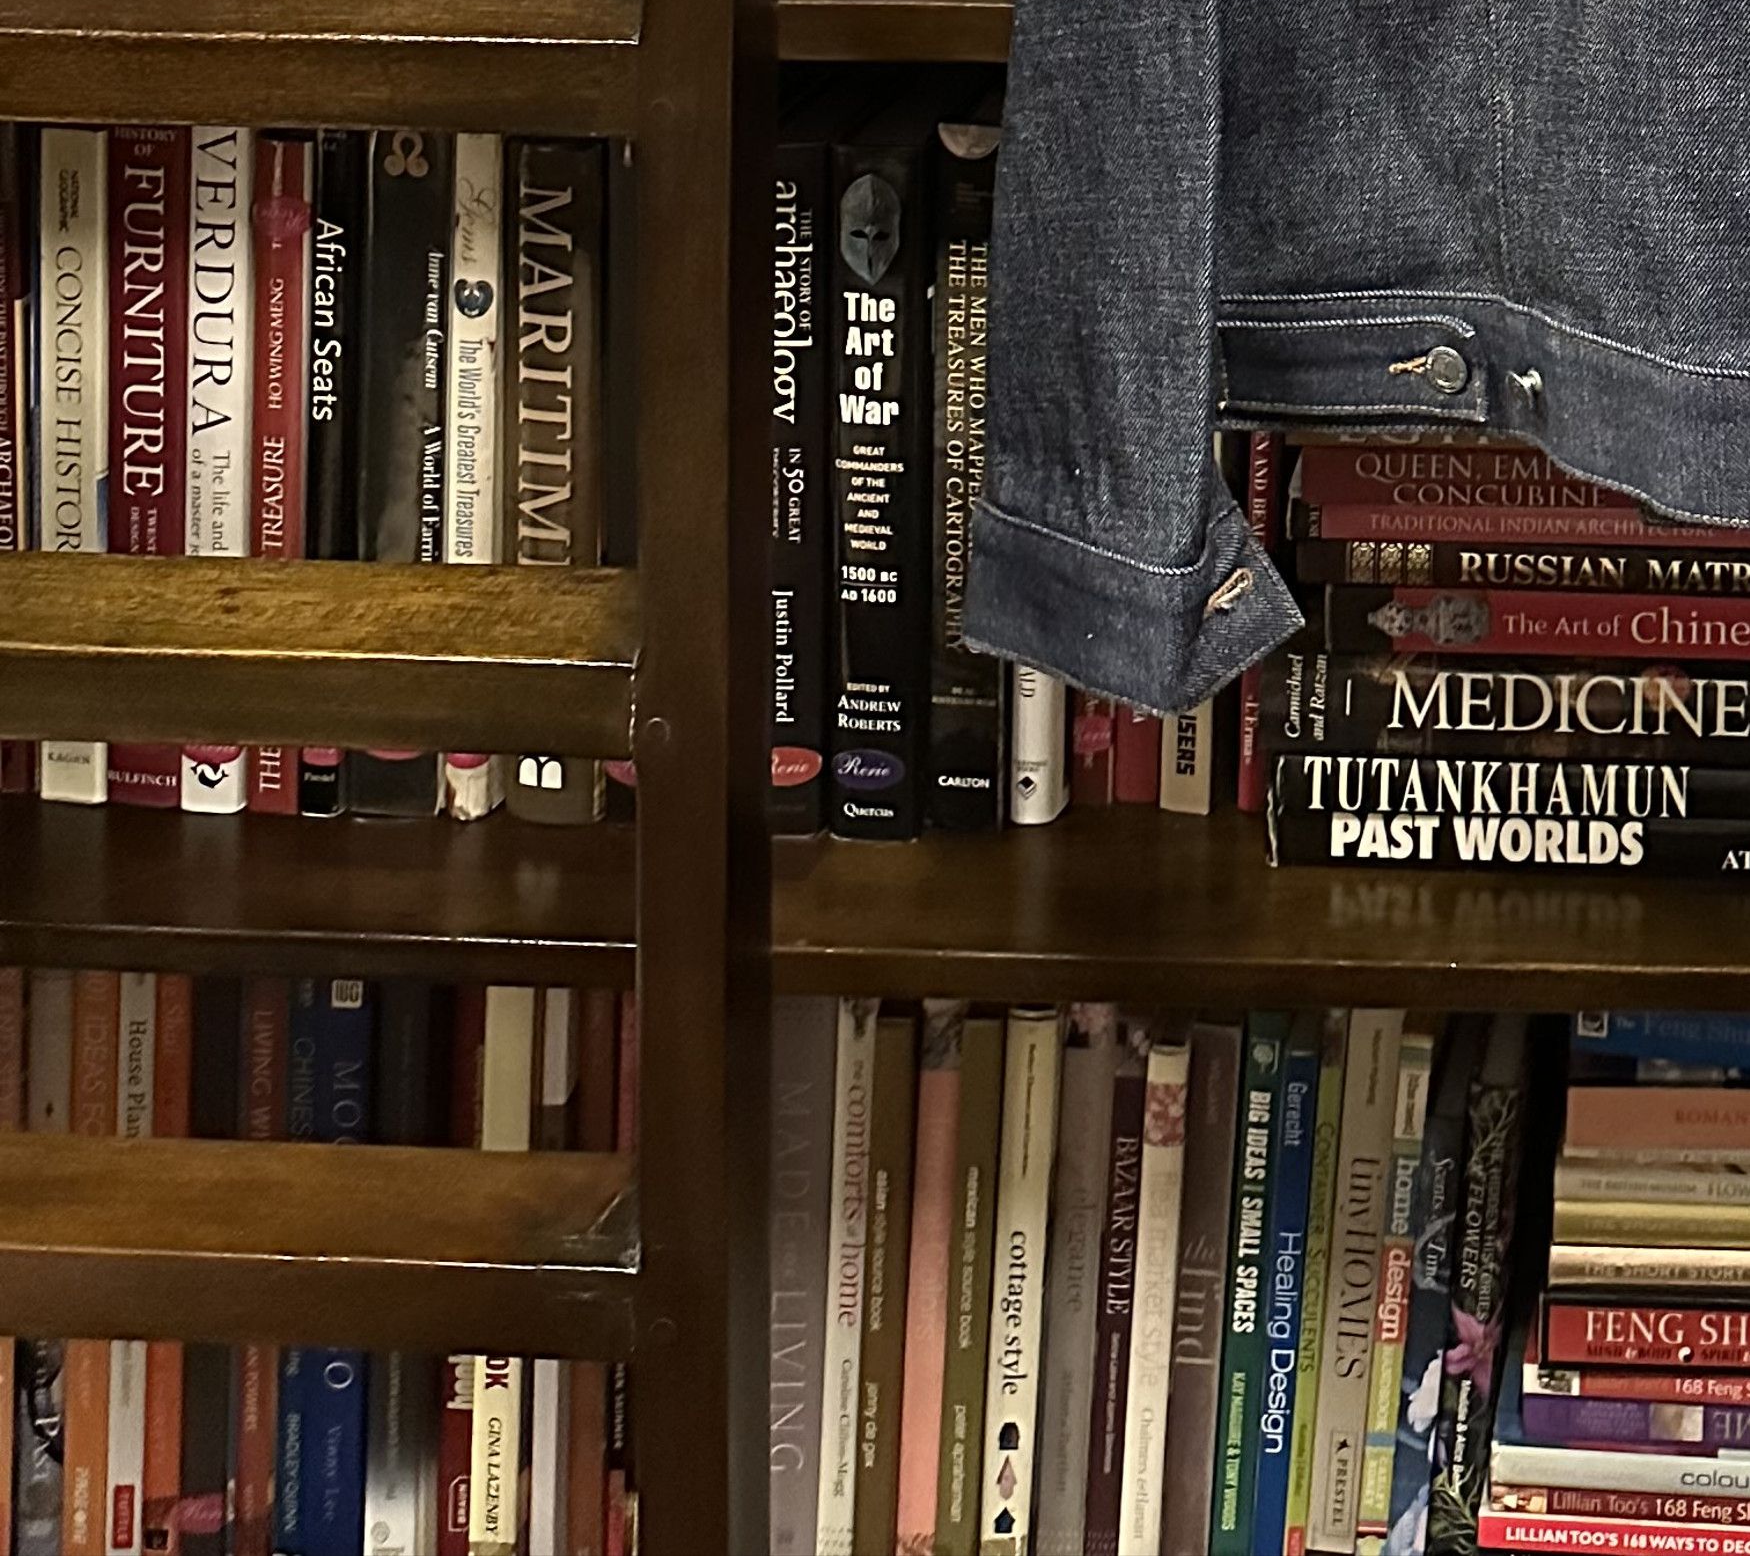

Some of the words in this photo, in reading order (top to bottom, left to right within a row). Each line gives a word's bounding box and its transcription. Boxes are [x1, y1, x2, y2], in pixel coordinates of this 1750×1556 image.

[192, 129, 238, 437] VERDURA
[314, 218, 346, 328] African
[123, 166, 165, 497] FURNITURE
[843, 292, 896, 322] The
[845, 327, 895, 357] Art
[312, 338, 342, 422] Seats
[854, 361, 883, 390] of
[839, 393, 899, 426] War
[1459, 551, 1627, 587] RUSSIAN
[1305, 757, 1690, 817] TUTANKHAMUN
[1330, 813, 1440, 860] PAST
[1454, 815, 1644, 866] WORLDS
[1001, 1230, 1027, 1329] cottage
[1267, 1231, 1302, 1340] Healing
[1586, 1311, 1684, 1345] FENG
[999, 1335, 1028, 1396] style
[1261, 1348, 1296, 1455] Design
